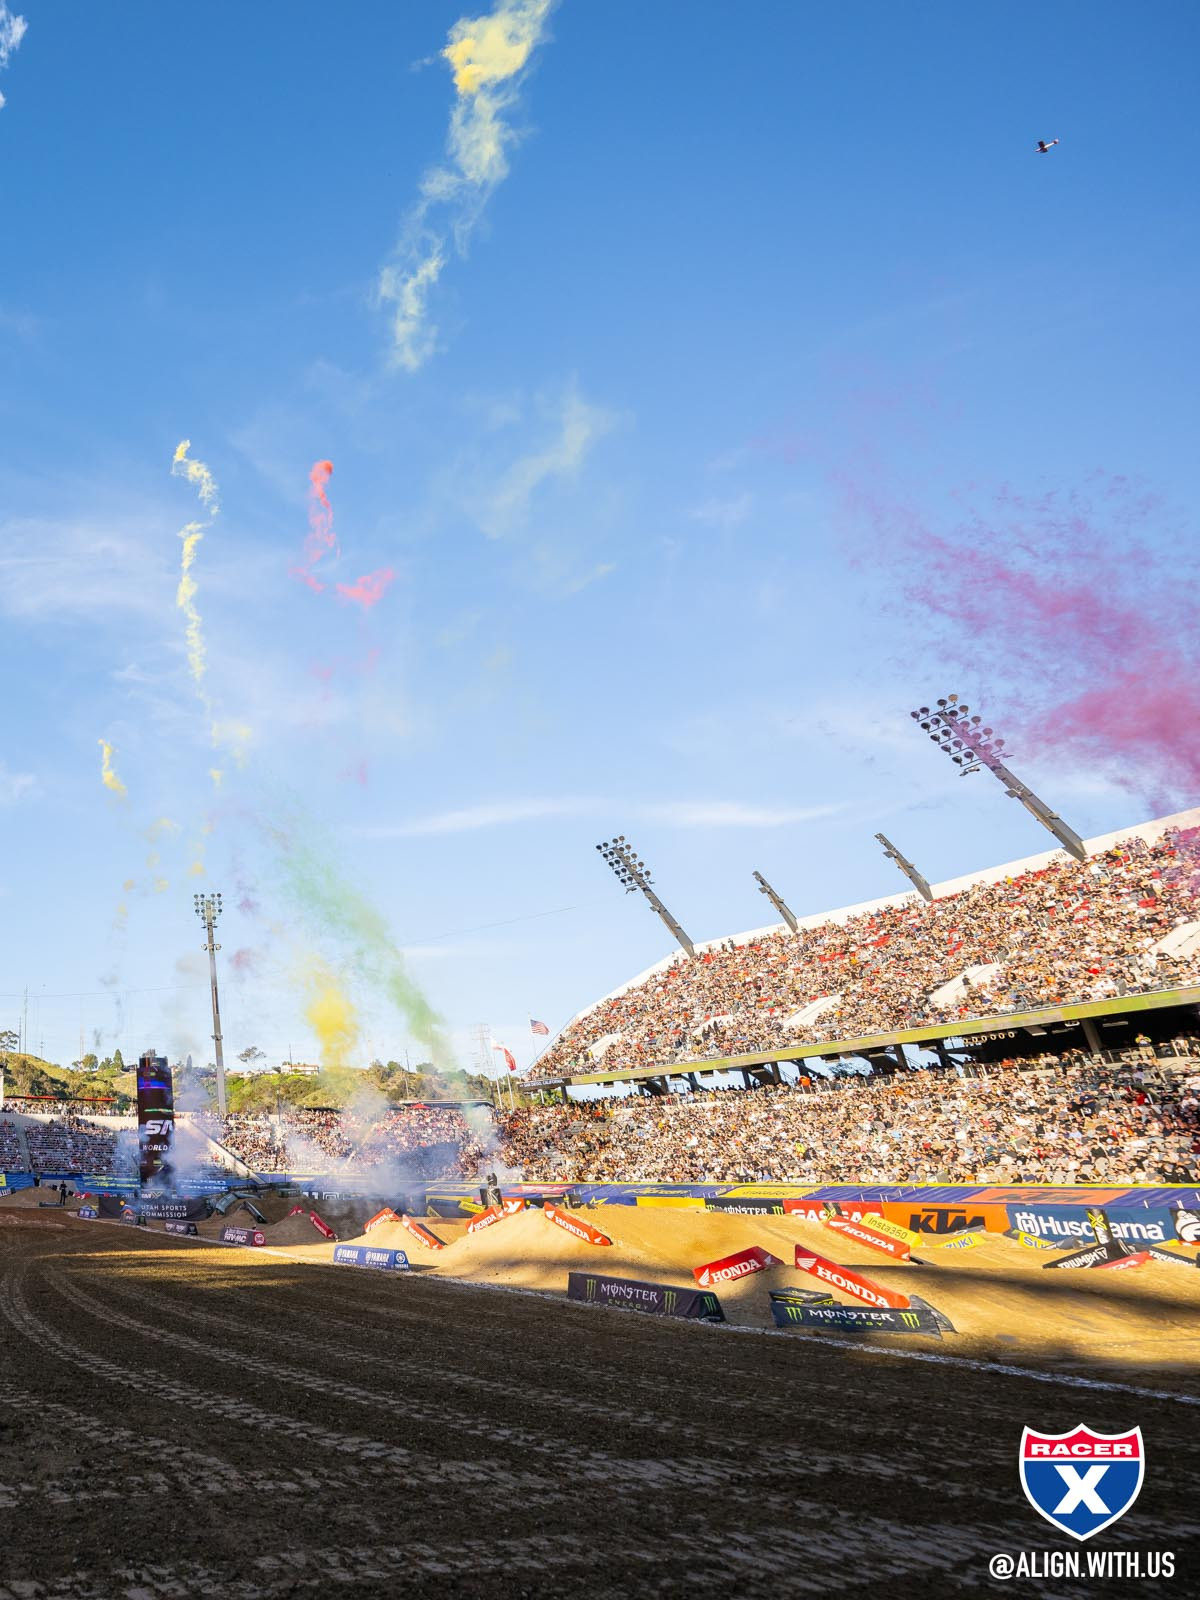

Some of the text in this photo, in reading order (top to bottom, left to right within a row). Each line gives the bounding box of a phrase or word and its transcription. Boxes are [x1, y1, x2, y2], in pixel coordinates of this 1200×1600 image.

[473, 1213, 497, 1230] HONDA
[555, 1216, 591, 1242] HONDA
[867, 1216, 908, 1240] Insta360
[909, 1208, 986, 1234] KTM
[408, 1226, 430, 1246] HONDA
[843, 1225, 895, 1253] HONDA
[1057, 1249, 1099, 1269] TRIUMPH
[711, 1258, 762, 1284] HONDA
[600, 1283, 659, 1304] MONSTER
[816, 1264, 890, 1309] HONDA
[608, 1299, 649, 1310] ENERGY
[809, 1309, 895, 1323] MONSTER
[824, 1318, 884, 1327] ENERGY
